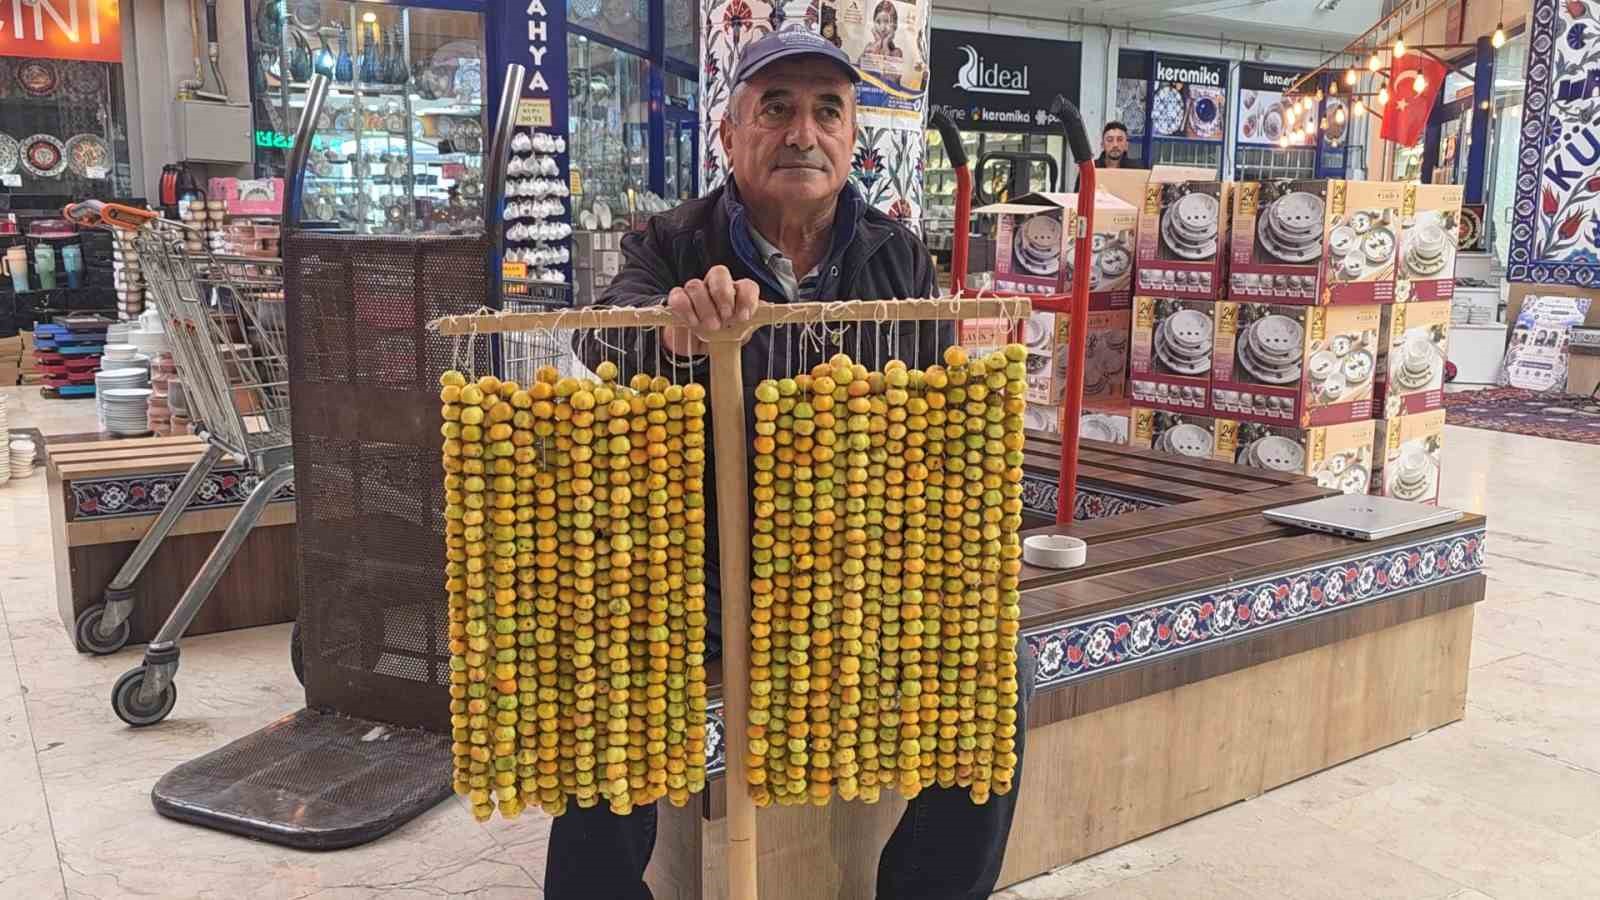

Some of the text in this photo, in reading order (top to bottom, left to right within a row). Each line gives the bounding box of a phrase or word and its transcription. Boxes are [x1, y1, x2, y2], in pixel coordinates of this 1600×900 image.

[0, 0, 101, 45] INI
[526, 0, 549, 92] AHYA
[979, 56, 1028, 89] ideal
[1156, 62, 1220, 85] keramika
[982, 107, 1031, 123] keramika
[1543, 114, 1600, 193] KÜ
